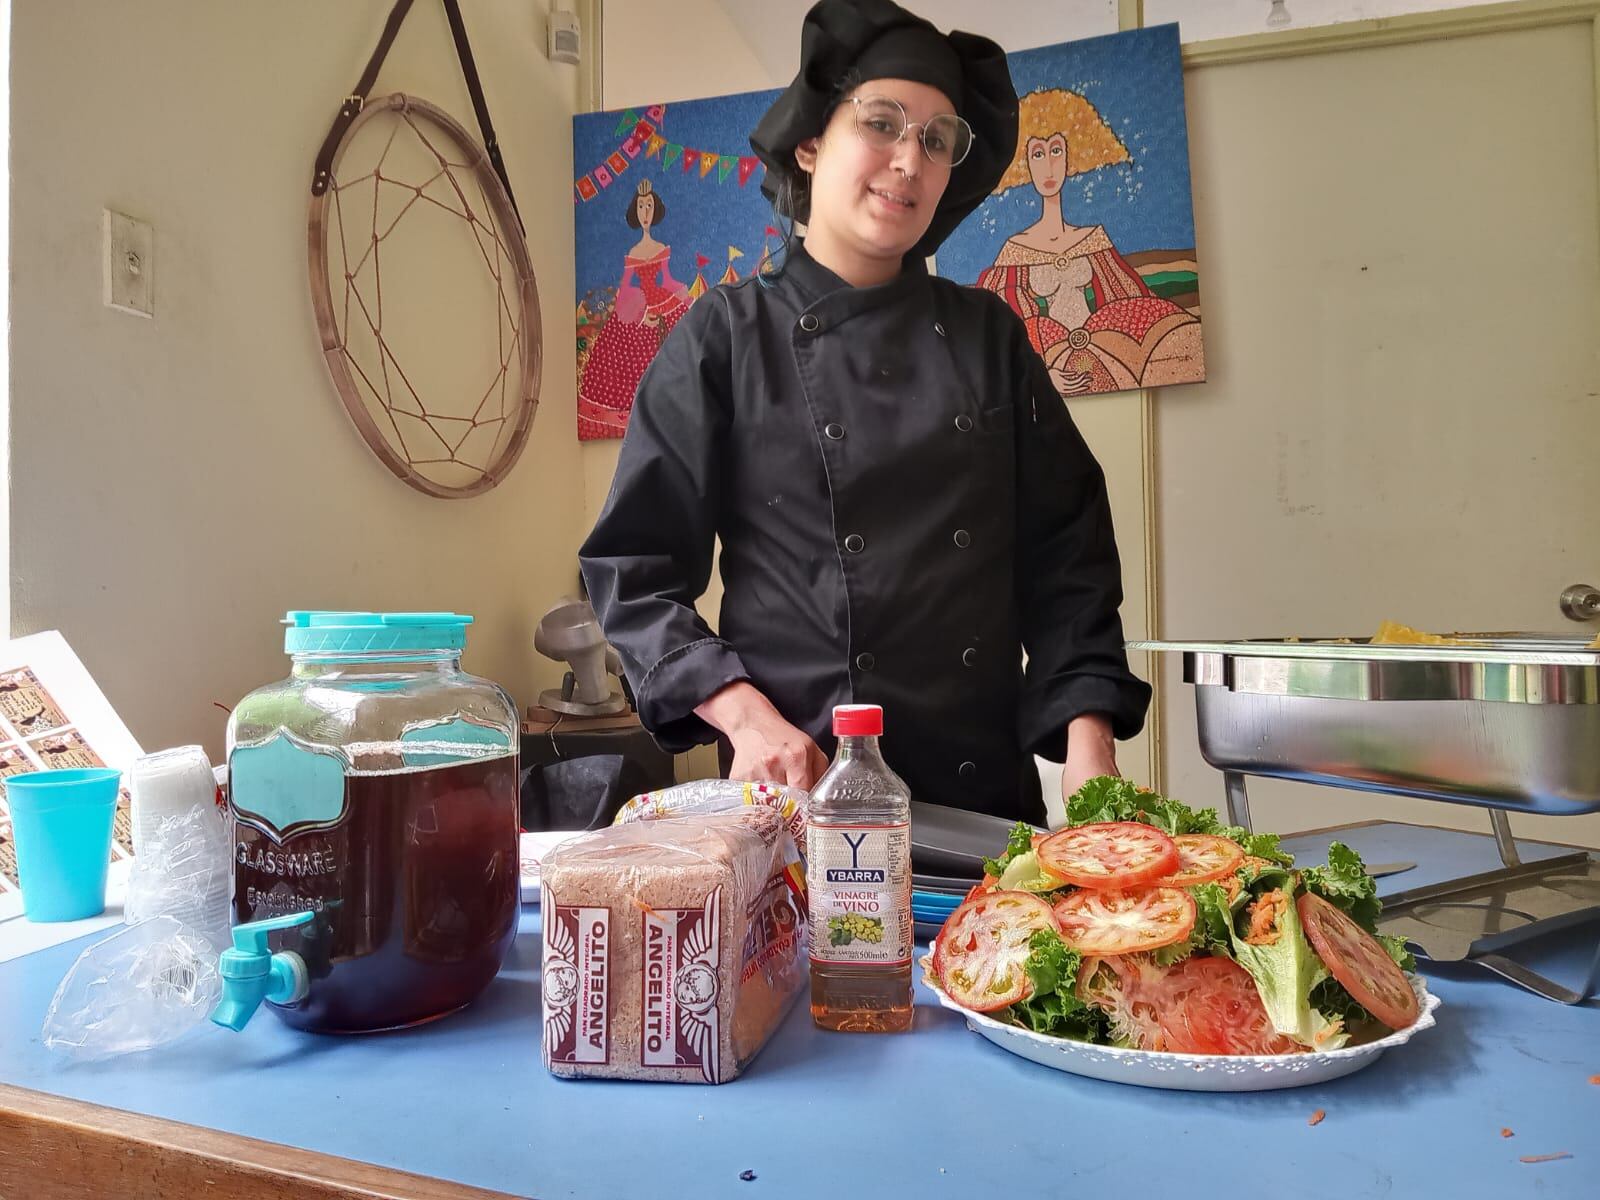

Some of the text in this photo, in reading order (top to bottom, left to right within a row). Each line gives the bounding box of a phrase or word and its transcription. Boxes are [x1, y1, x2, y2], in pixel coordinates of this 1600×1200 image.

[236, 841, 337, 877] GLASSWARE
[840, 832, 870, 869] Y
[829, 871, 882, 882] YBARRA
[833, 891, 879, 900] VINAGRE
[842, 901, 880, 913] VINO
[589, 921, 605, 1049] ANGELITO
[647, 924, 663, 1053] ANGELITO
